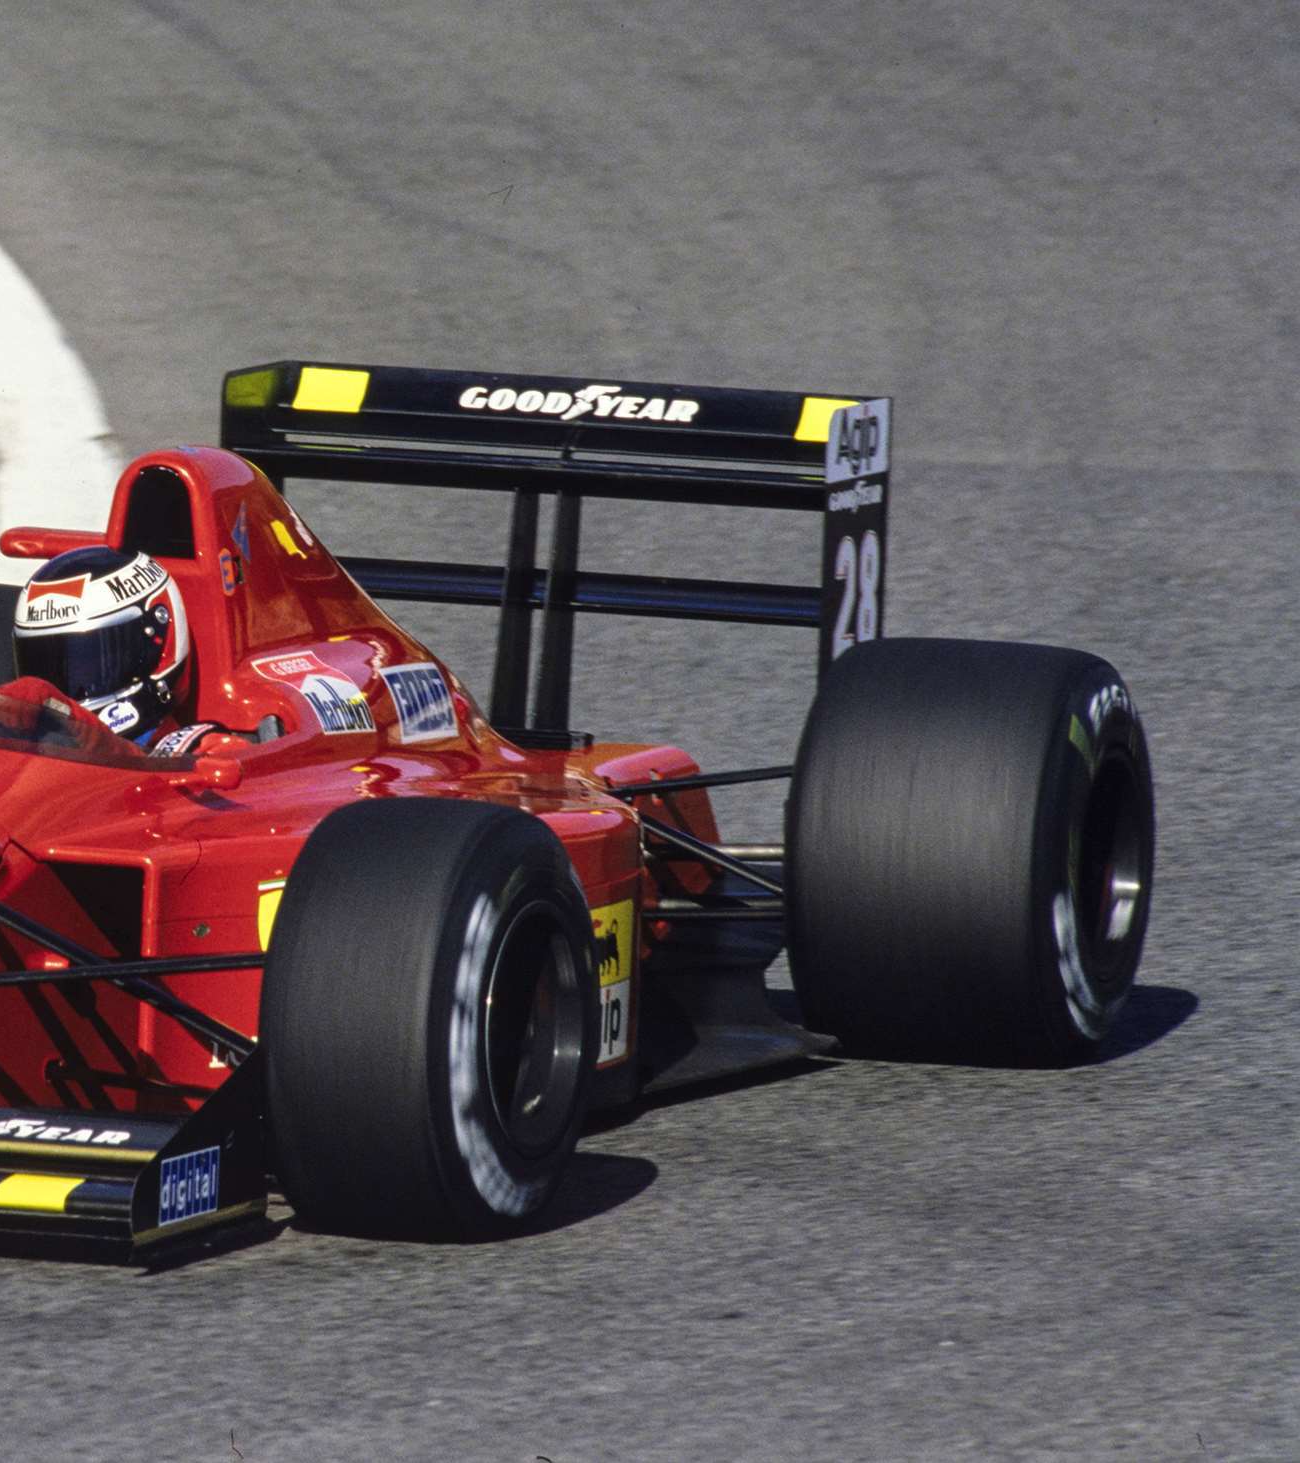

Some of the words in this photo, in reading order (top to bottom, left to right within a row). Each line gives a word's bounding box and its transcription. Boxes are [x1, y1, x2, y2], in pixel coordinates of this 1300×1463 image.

[459, 385, 699, 422] GOODYEAR
[836, 404, 879, 475] Agip
[26, 600, 80, 622] Marlboro
[832, 529, 880, 661] 28
[600, 988, 622, 1055] ip
[160, 1164, 217, 1211] digital
